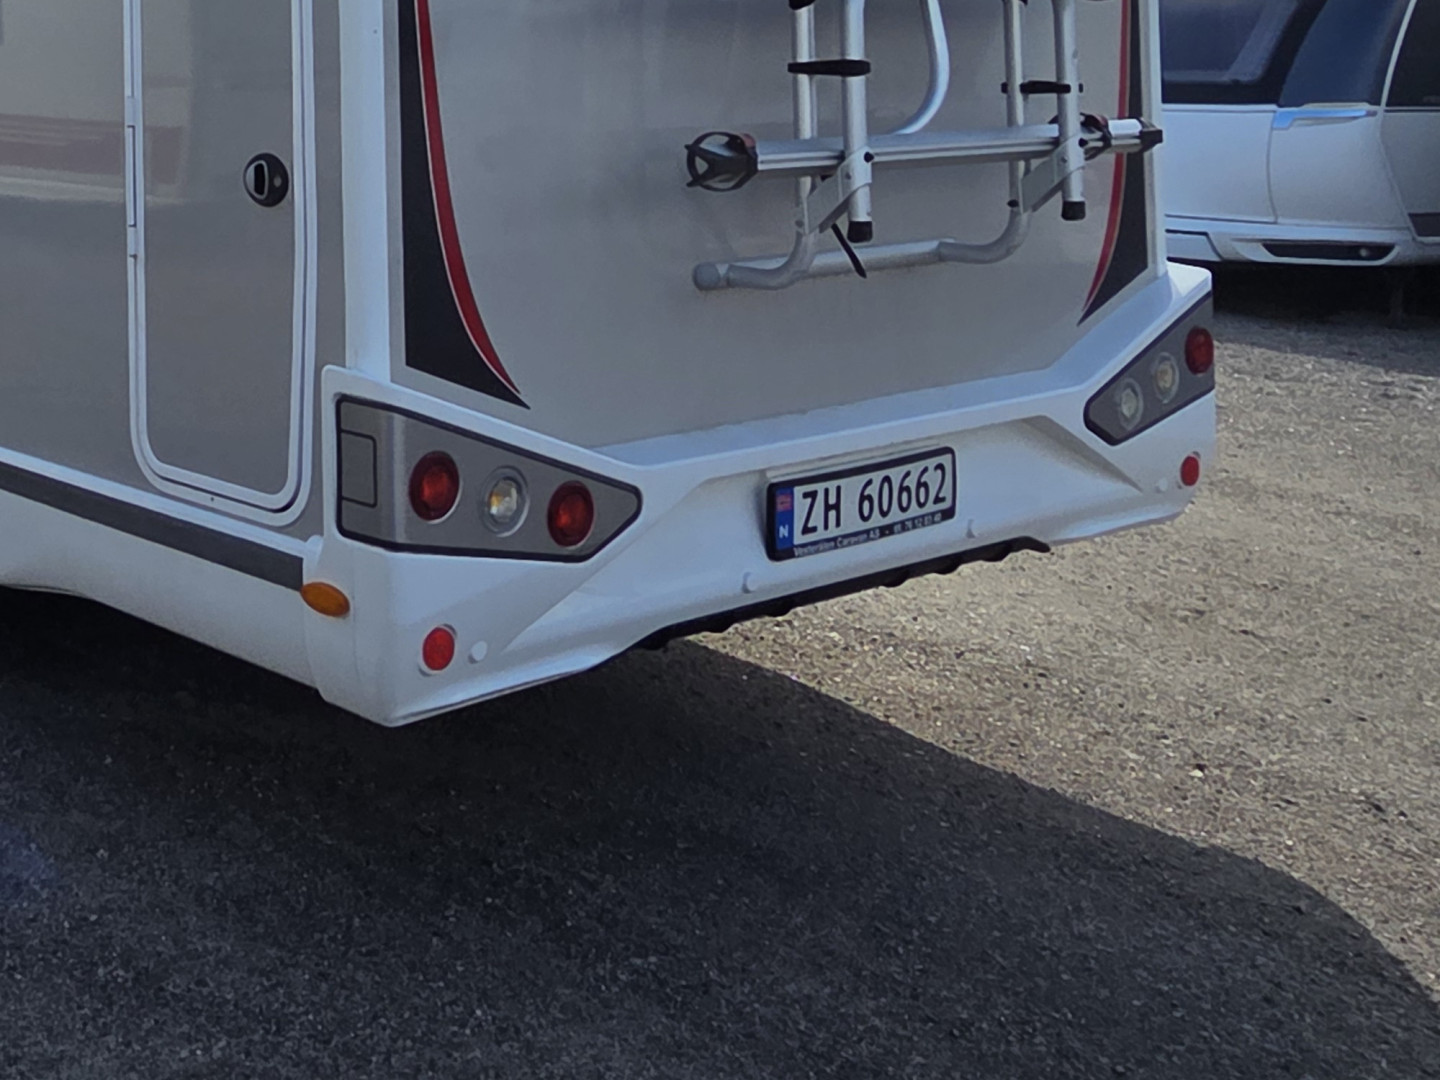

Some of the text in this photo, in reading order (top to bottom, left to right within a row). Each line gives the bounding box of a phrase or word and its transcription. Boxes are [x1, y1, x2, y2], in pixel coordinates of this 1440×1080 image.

[778, 463, 947, 538] N ZH 60662
